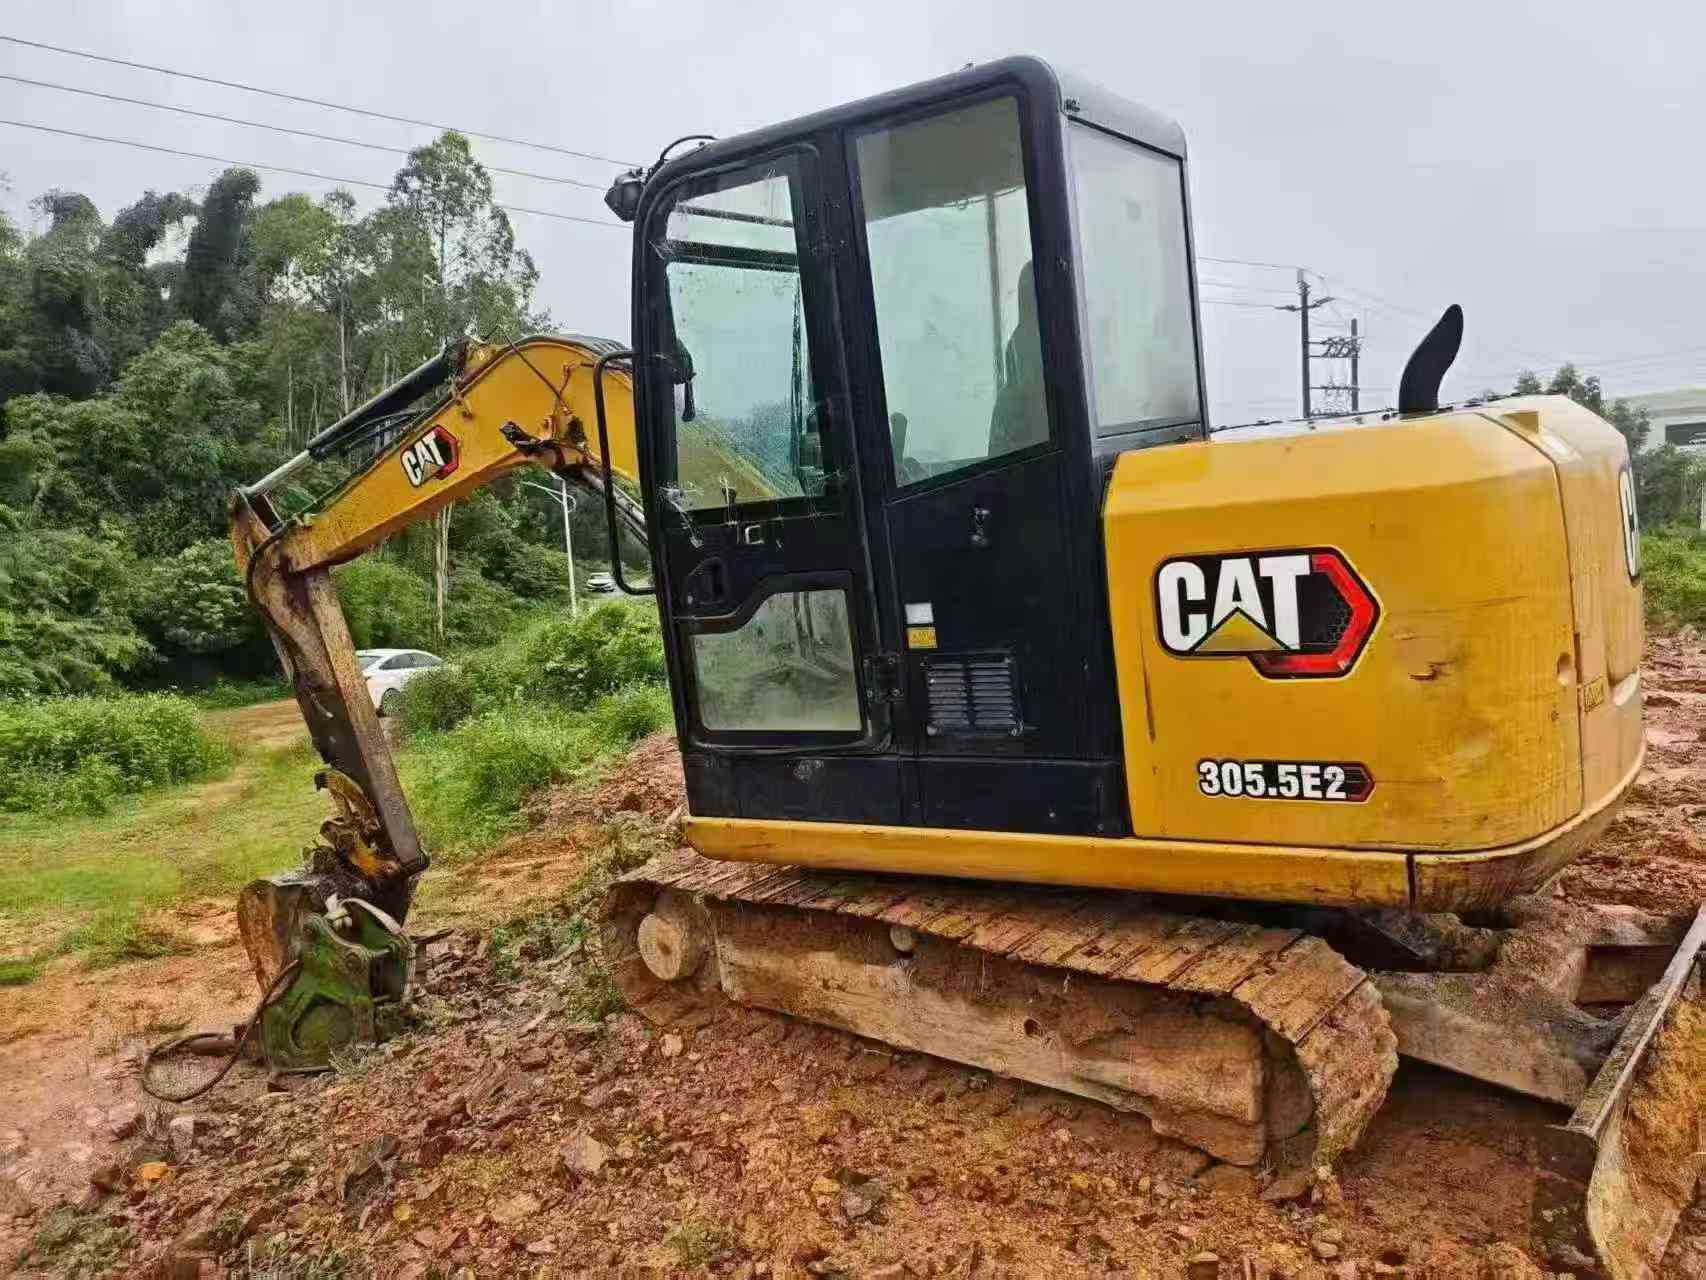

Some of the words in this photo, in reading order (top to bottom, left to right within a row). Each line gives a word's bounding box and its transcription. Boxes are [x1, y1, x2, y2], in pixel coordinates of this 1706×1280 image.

[402, 431, 445, 485] CAT
[1158, 555, 1310, 651] CAT
[1199, 761, 1347, 799] 305.5E2
